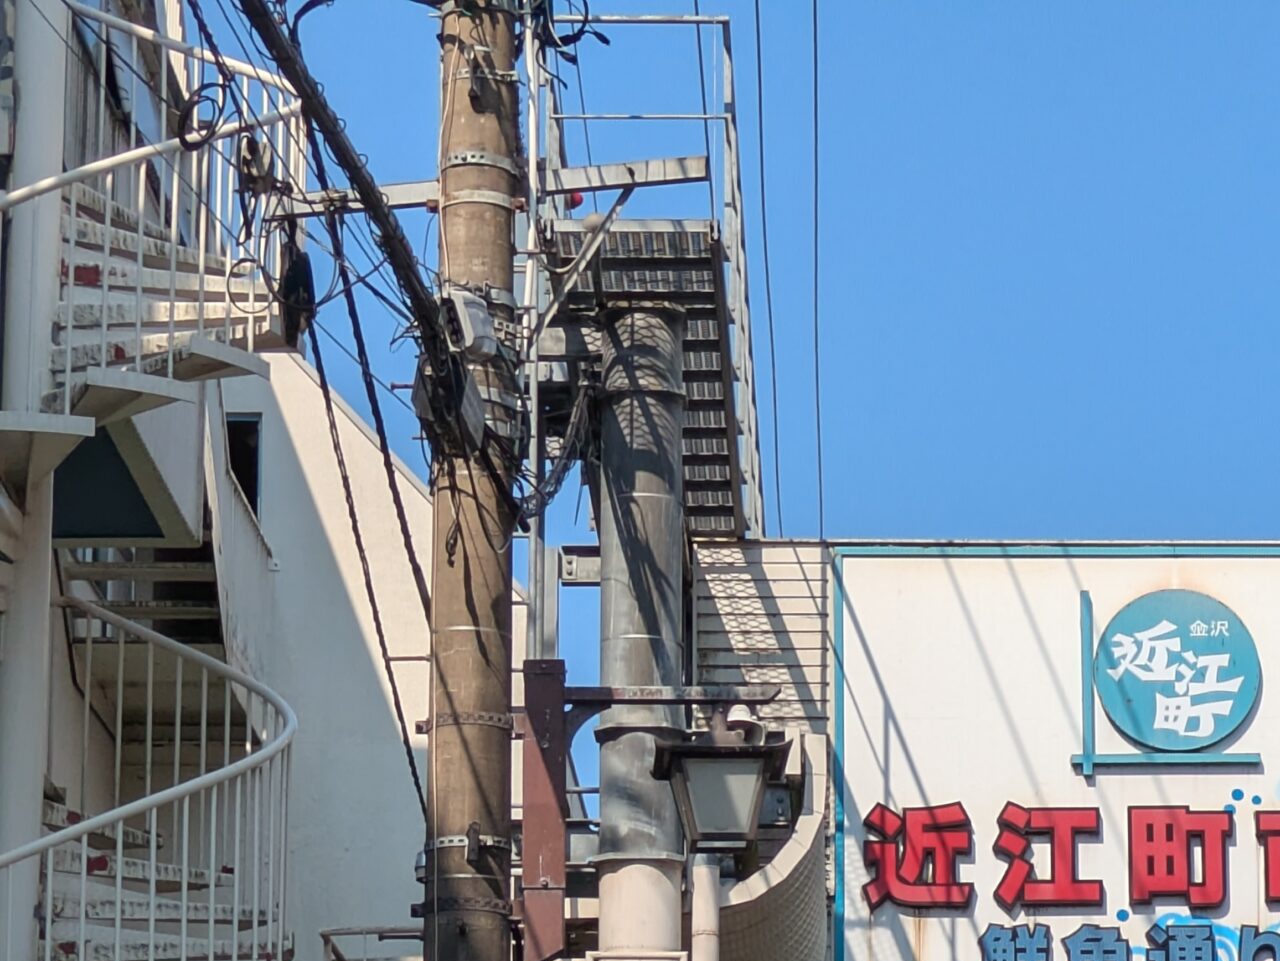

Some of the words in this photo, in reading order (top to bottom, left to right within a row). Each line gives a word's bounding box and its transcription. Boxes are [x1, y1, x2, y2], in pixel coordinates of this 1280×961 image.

[1189, 620, 1230, 638] 金沢
[1106, 619, 1245, 738] 近江町
